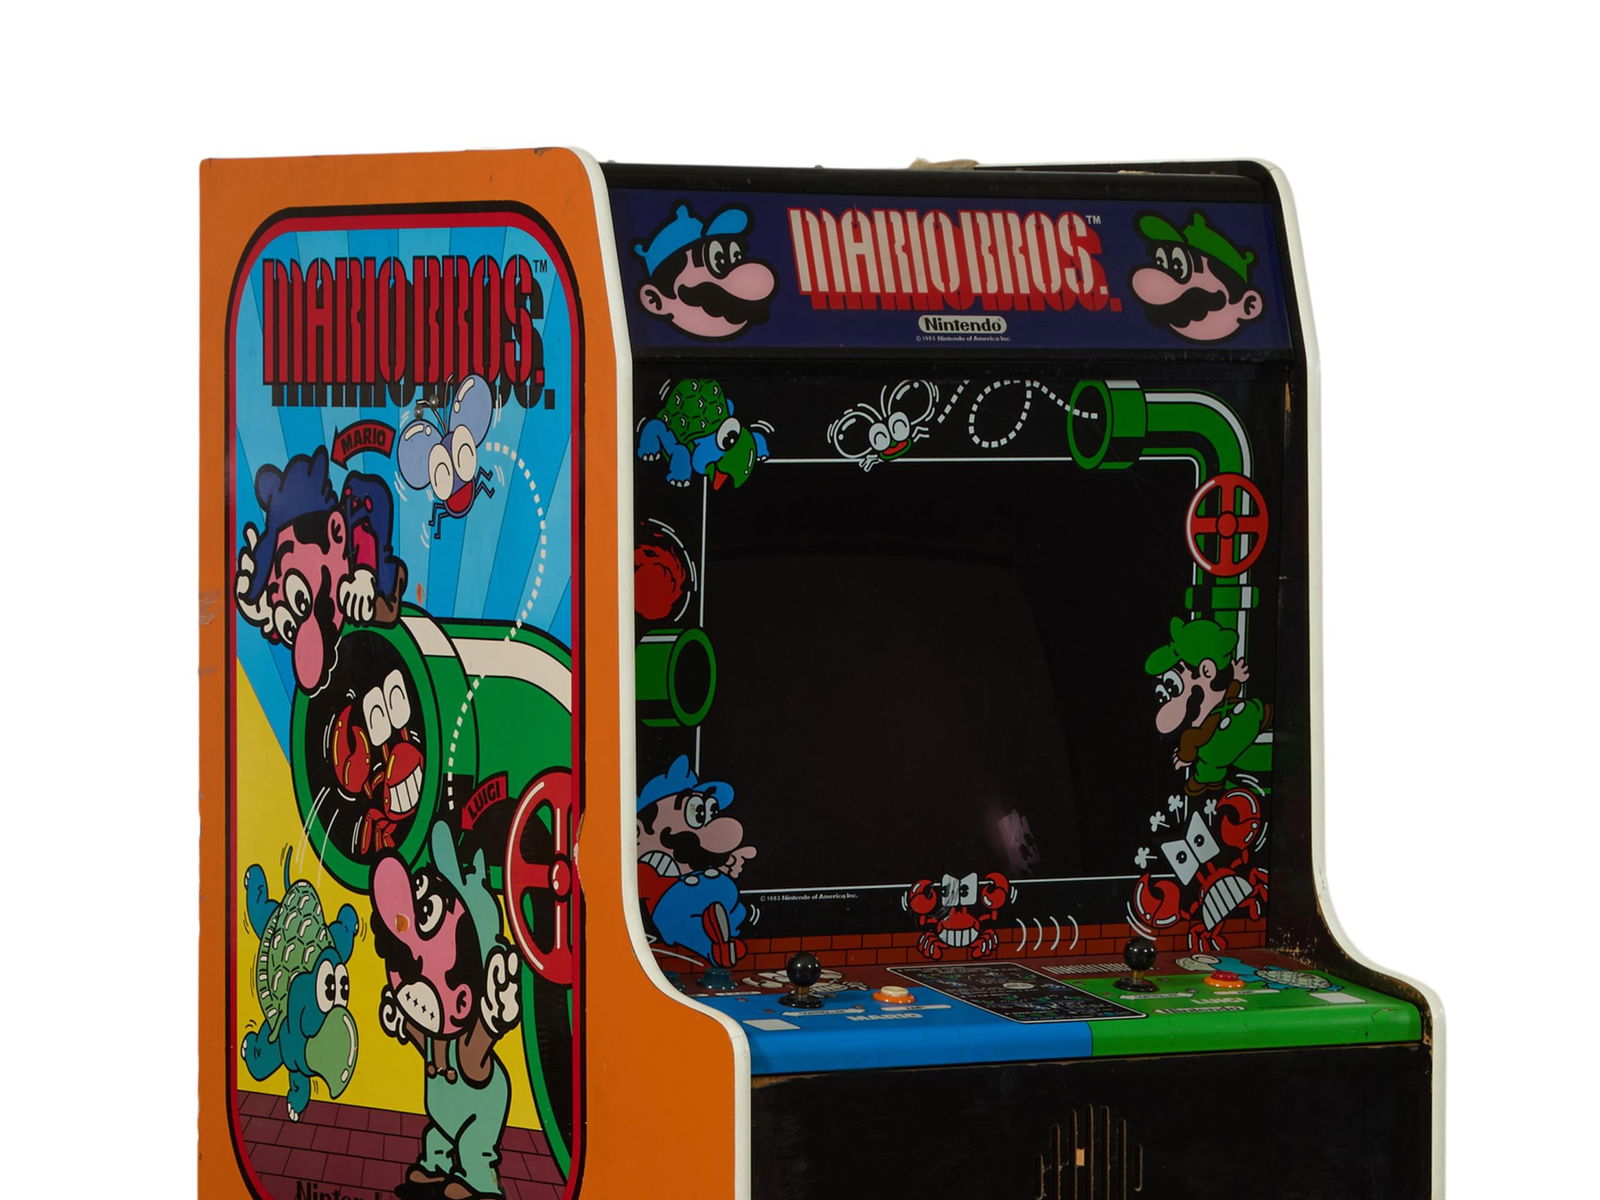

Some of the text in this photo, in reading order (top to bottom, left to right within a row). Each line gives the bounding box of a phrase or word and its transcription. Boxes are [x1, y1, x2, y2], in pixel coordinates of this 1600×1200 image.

[788, 207, 963, 300] MARIO
[957, 209, 1110, 301] BROS.
[262, 257, 409, 388] MARIO
[411, 254, 546, 389] BROS.
[924, 317, 1002, 332] Nintendo
[340, 427, 386, 456] MARIO
[467, 780, 501, 819] LUIGI
